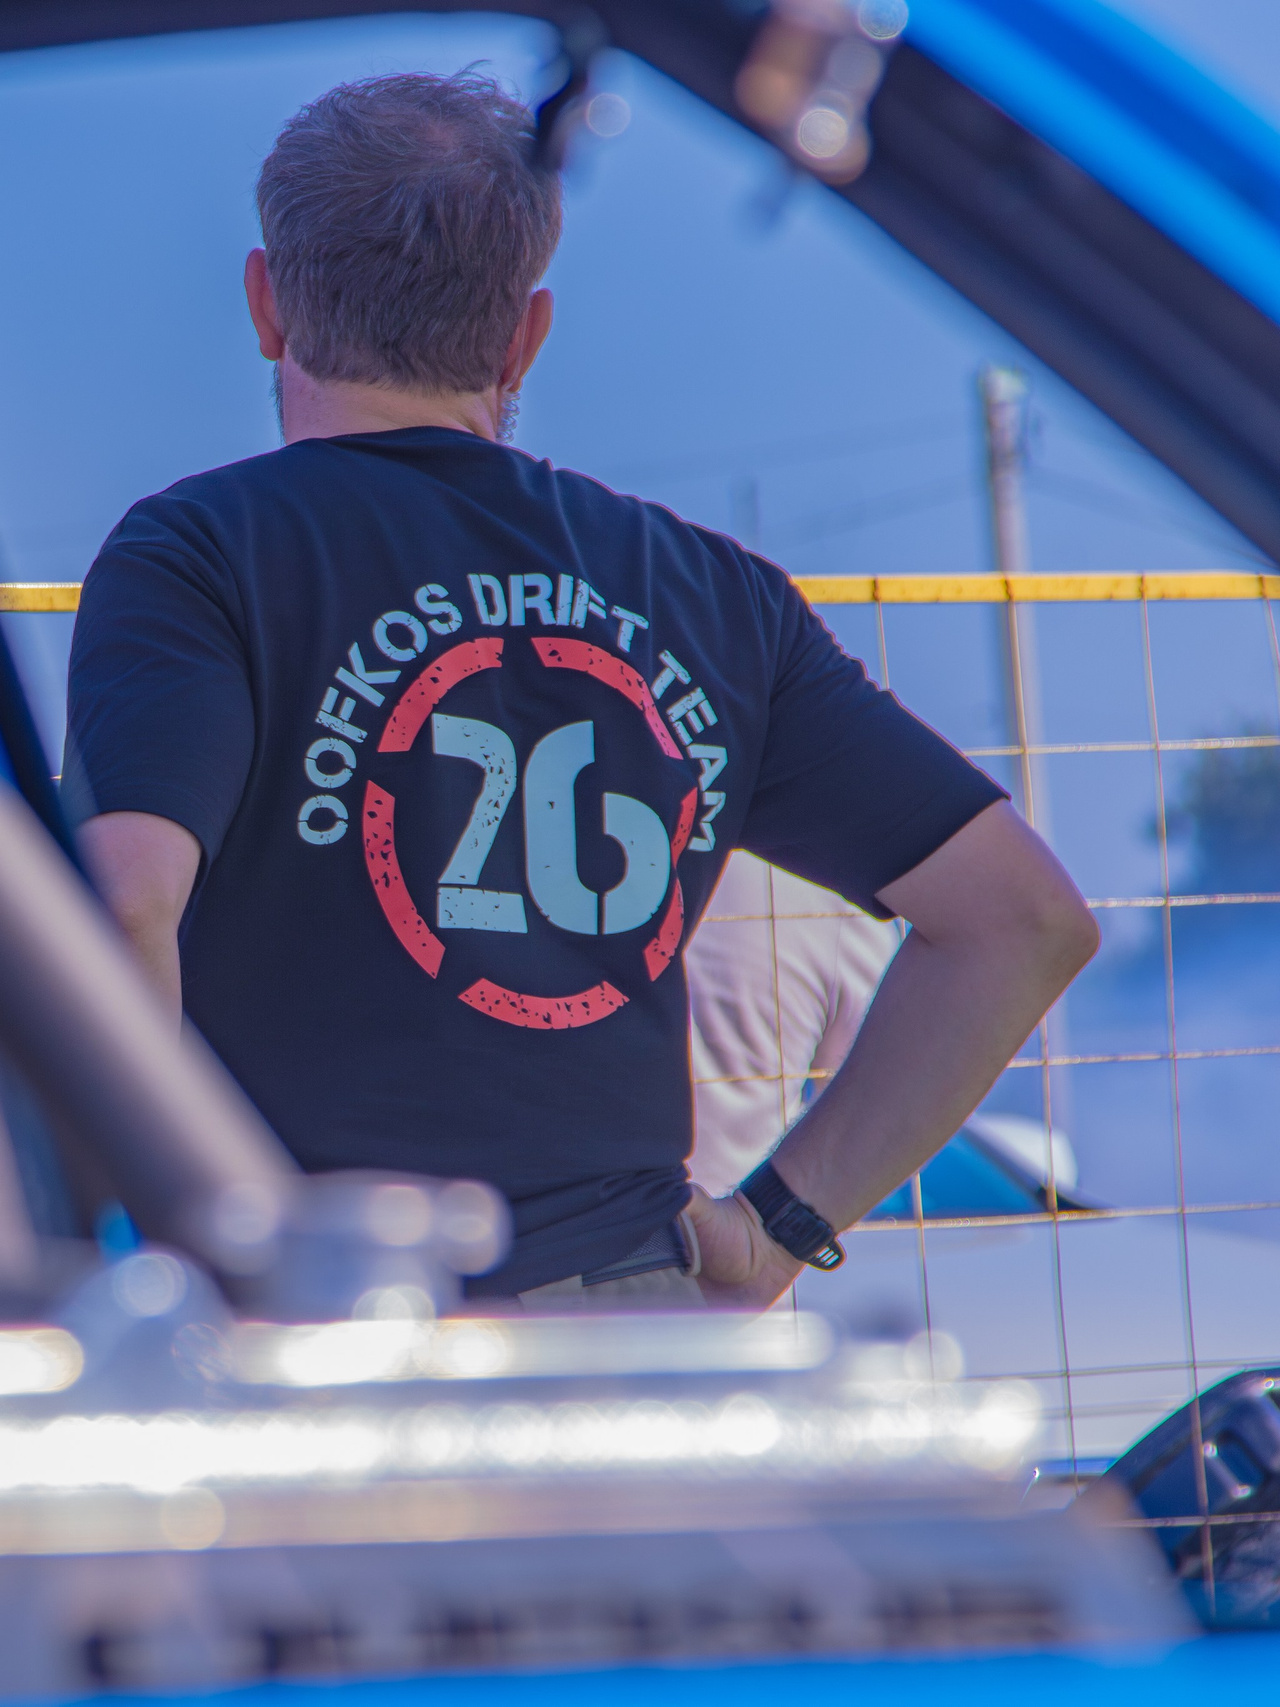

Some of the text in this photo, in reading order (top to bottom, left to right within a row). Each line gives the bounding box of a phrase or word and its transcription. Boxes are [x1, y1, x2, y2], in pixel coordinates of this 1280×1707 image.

[297, 573, 728, 852] OOFKOS DRIFT TEAM
[431, 713, 671, 935] 26
